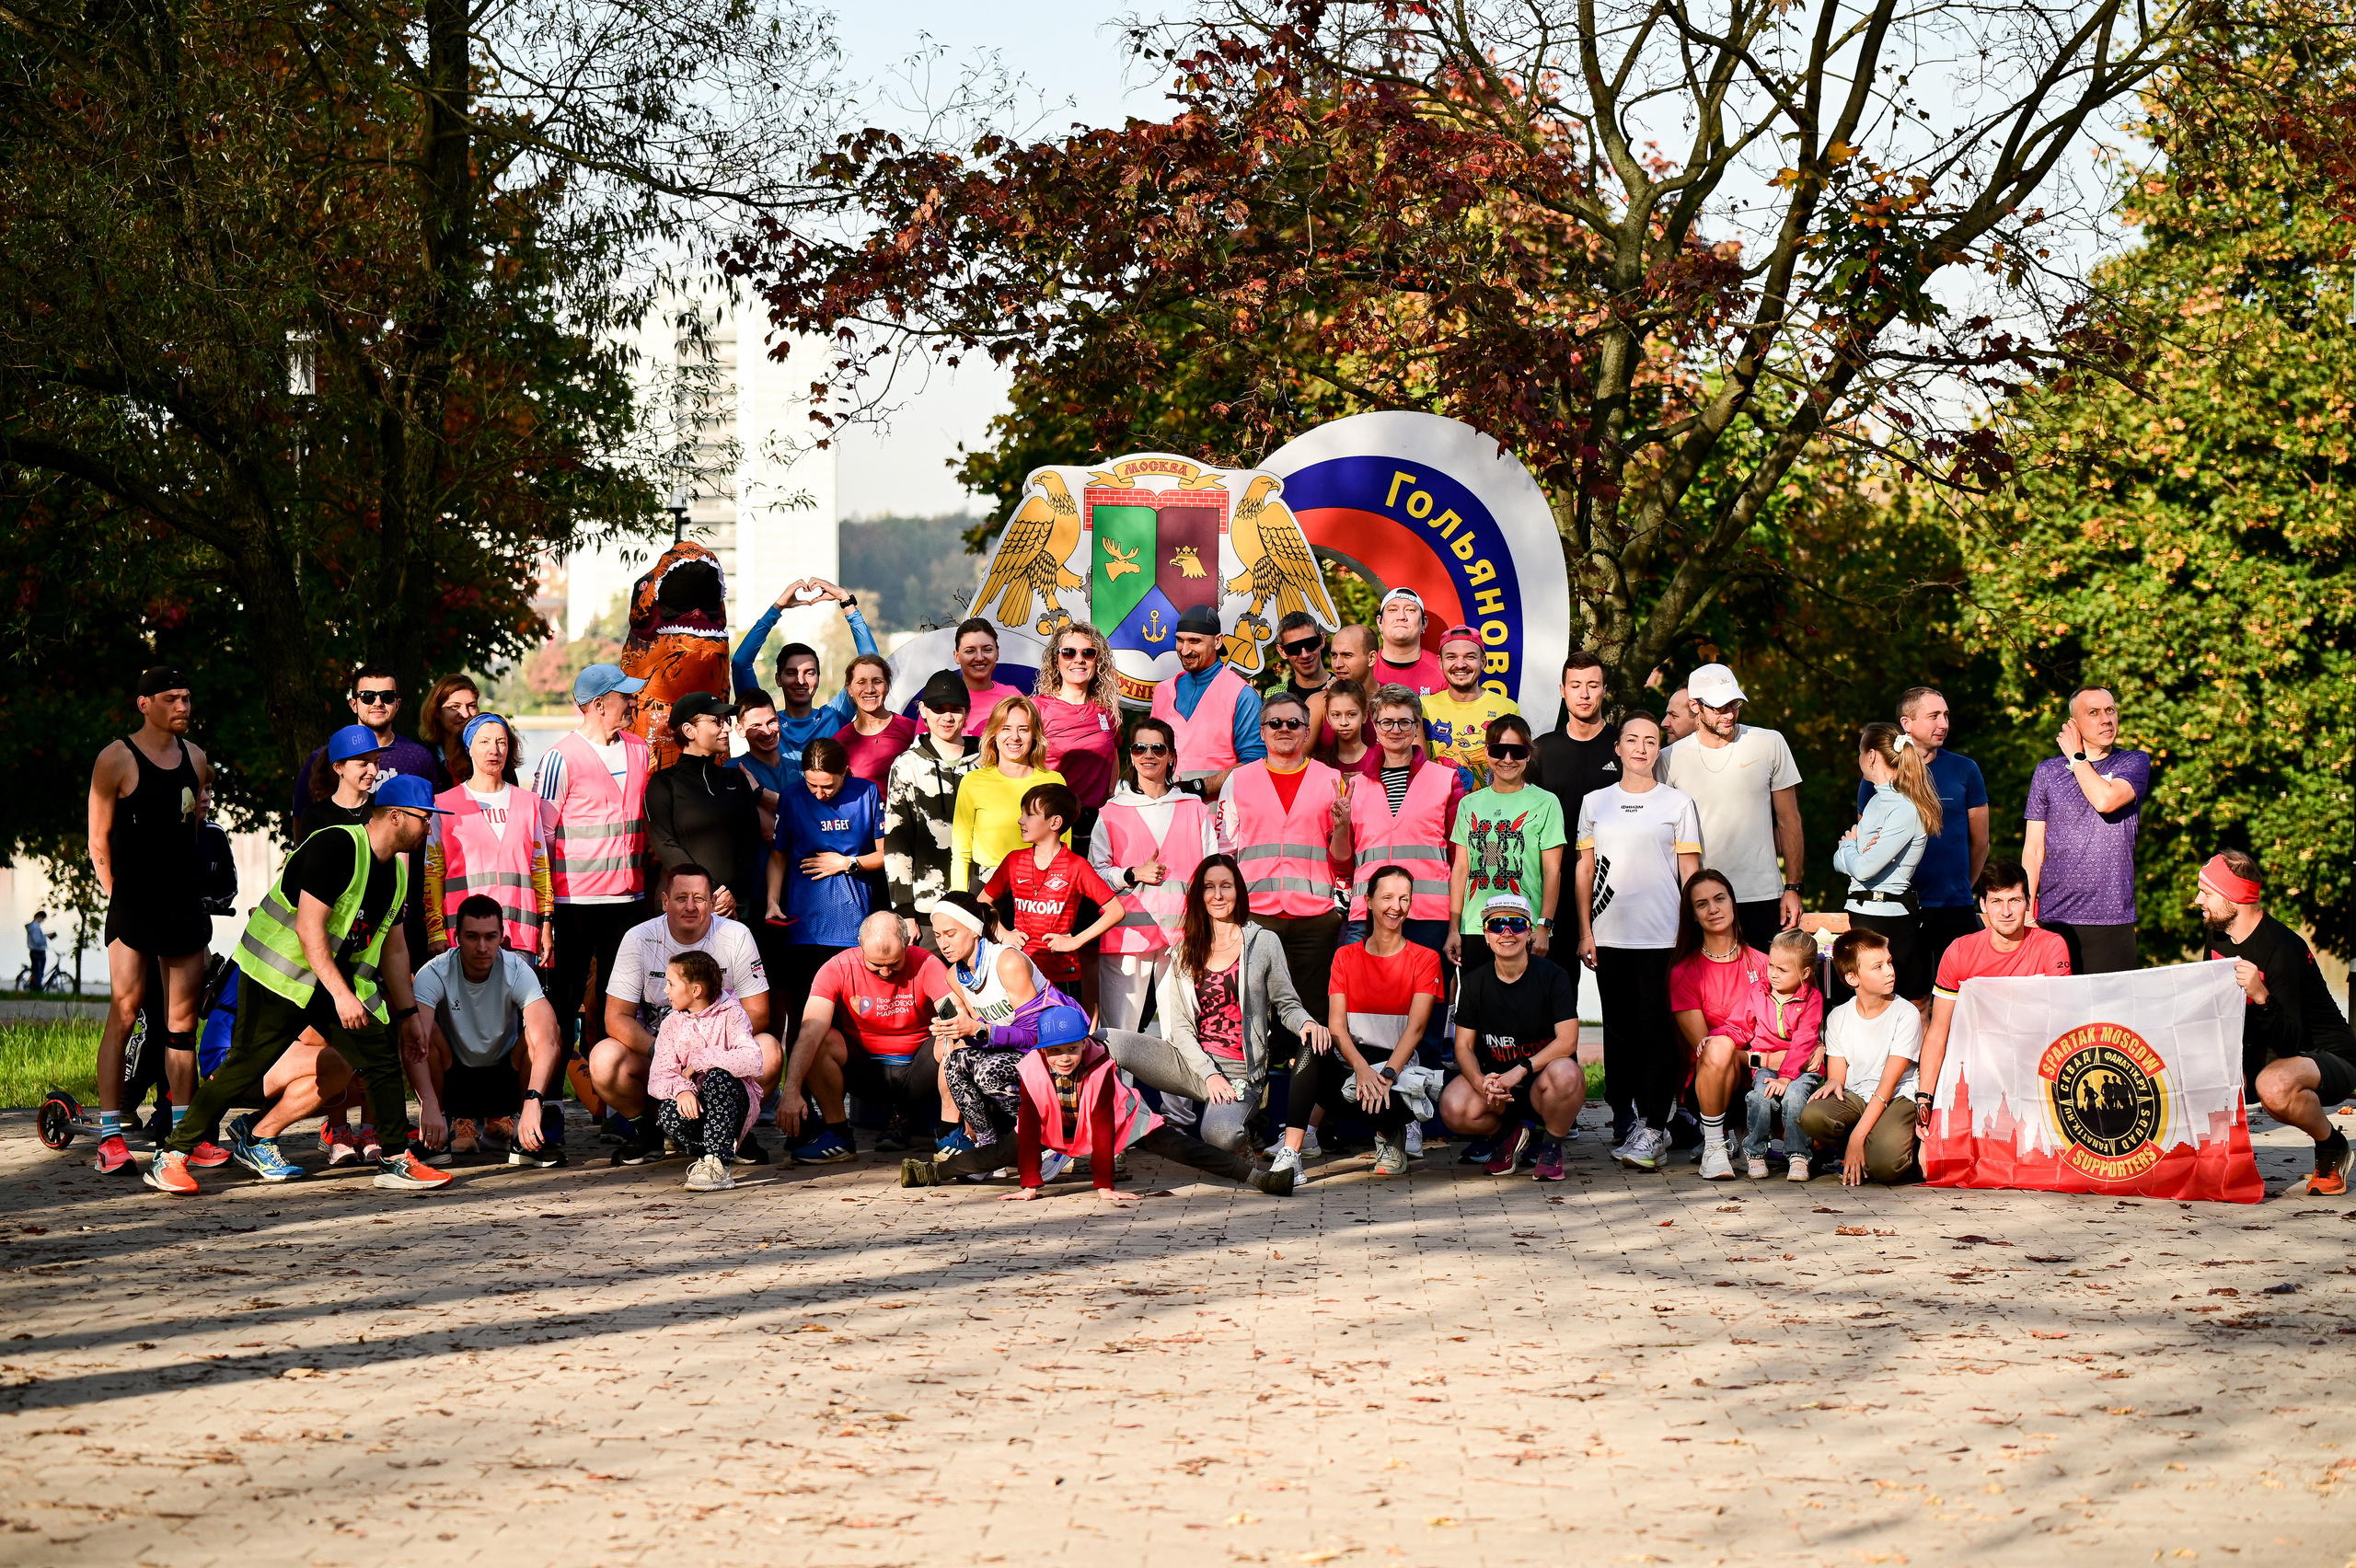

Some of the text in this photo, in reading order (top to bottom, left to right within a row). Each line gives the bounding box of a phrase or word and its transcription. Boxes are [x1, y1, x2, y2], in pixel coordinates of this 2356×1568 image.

[1125, 461, 1187, 476] МОСКВА
[2043, 1026, 2160, 1076] SPARTAK MOSCOW
[2060, 1051, 2091, 1092] СКВАД
[2120, 1108, 2151, 1149] SQUAD
[2072, 1146, 2157, 1178] SUPPORTERS
